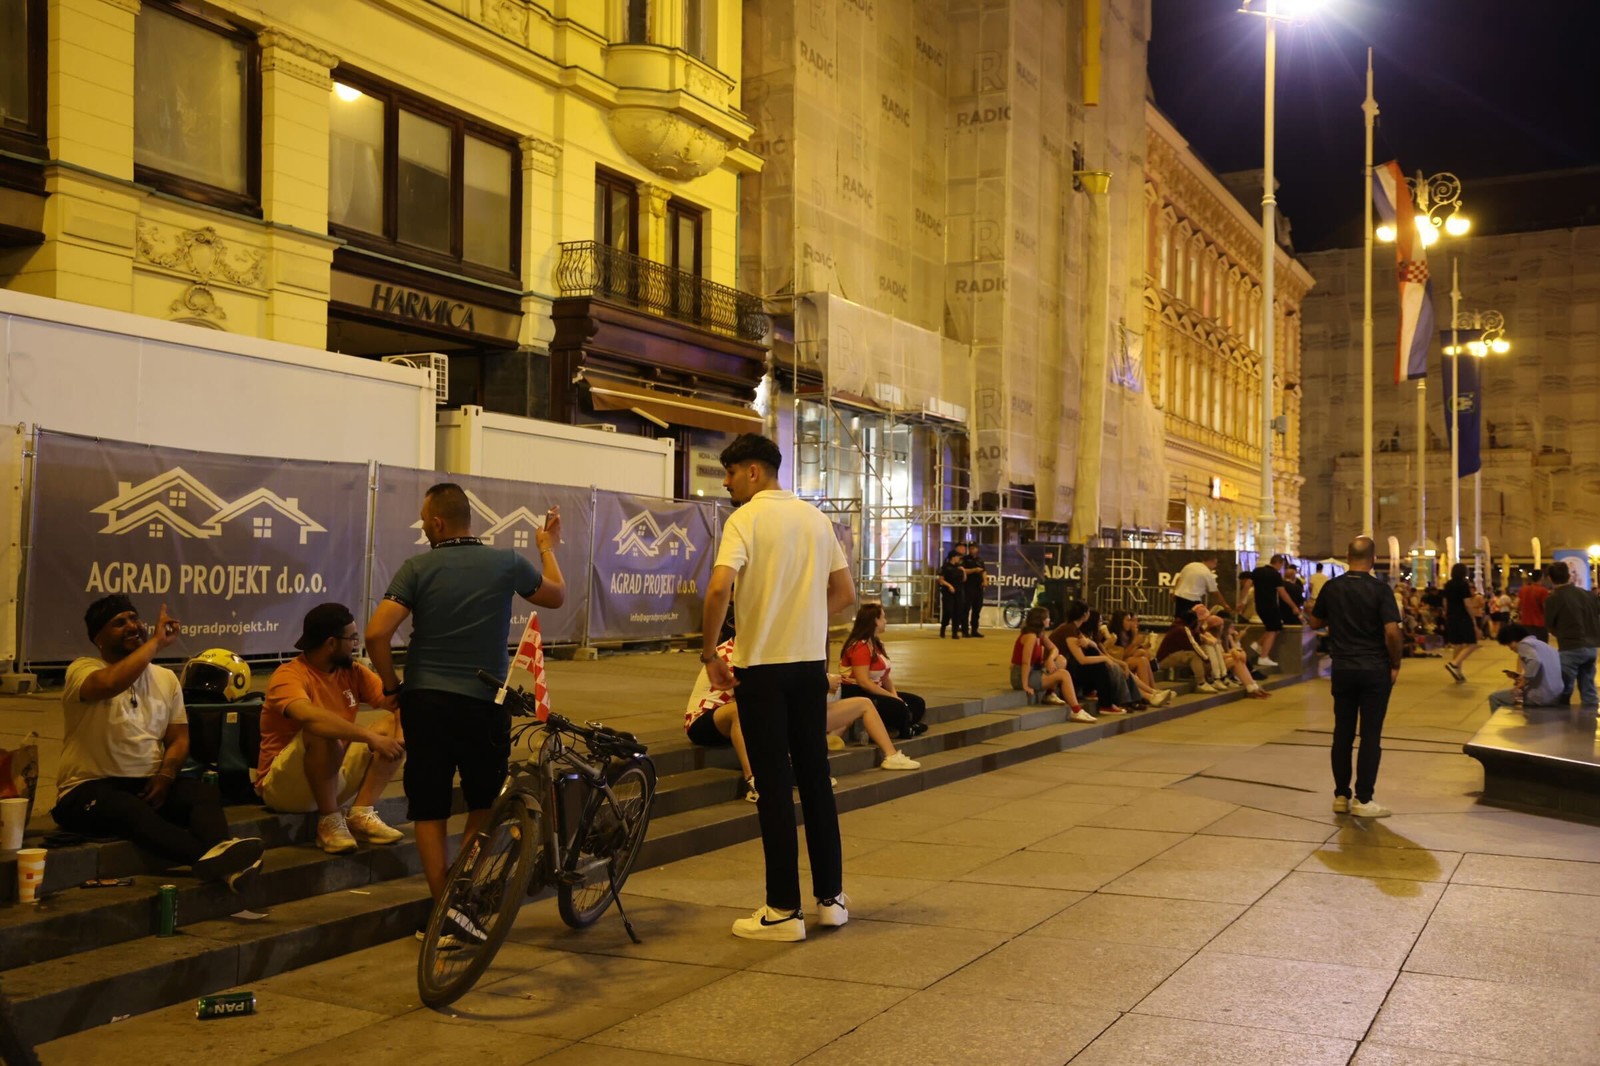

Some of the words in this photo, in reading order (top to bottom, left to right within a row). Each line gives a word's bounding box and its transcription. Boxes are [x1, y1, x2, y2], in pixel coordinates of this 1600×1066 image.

[801, 40, 834, 79] RADIĆ
[881, 93, 911, 128] RADIĆ
[842, 175, 873, 209] RADIĆ
[915, 208, 942, 237] RADIĆ
[371, 283, 475, 333] HARMICA
[85, 561, 171, 594] AGRAD
[179, 565, 271, 600] PROJEKT
[276, 566, 327, 594] d.o.o.
[610, 573, 641, 594] AGRAD
[643, 574, 675, 598] PROJEKT
[677, 575, 698, 594] d.o.o.
[986, 573, 1038, 588] merkur
[213, 1001, 245, 1014] PAN
